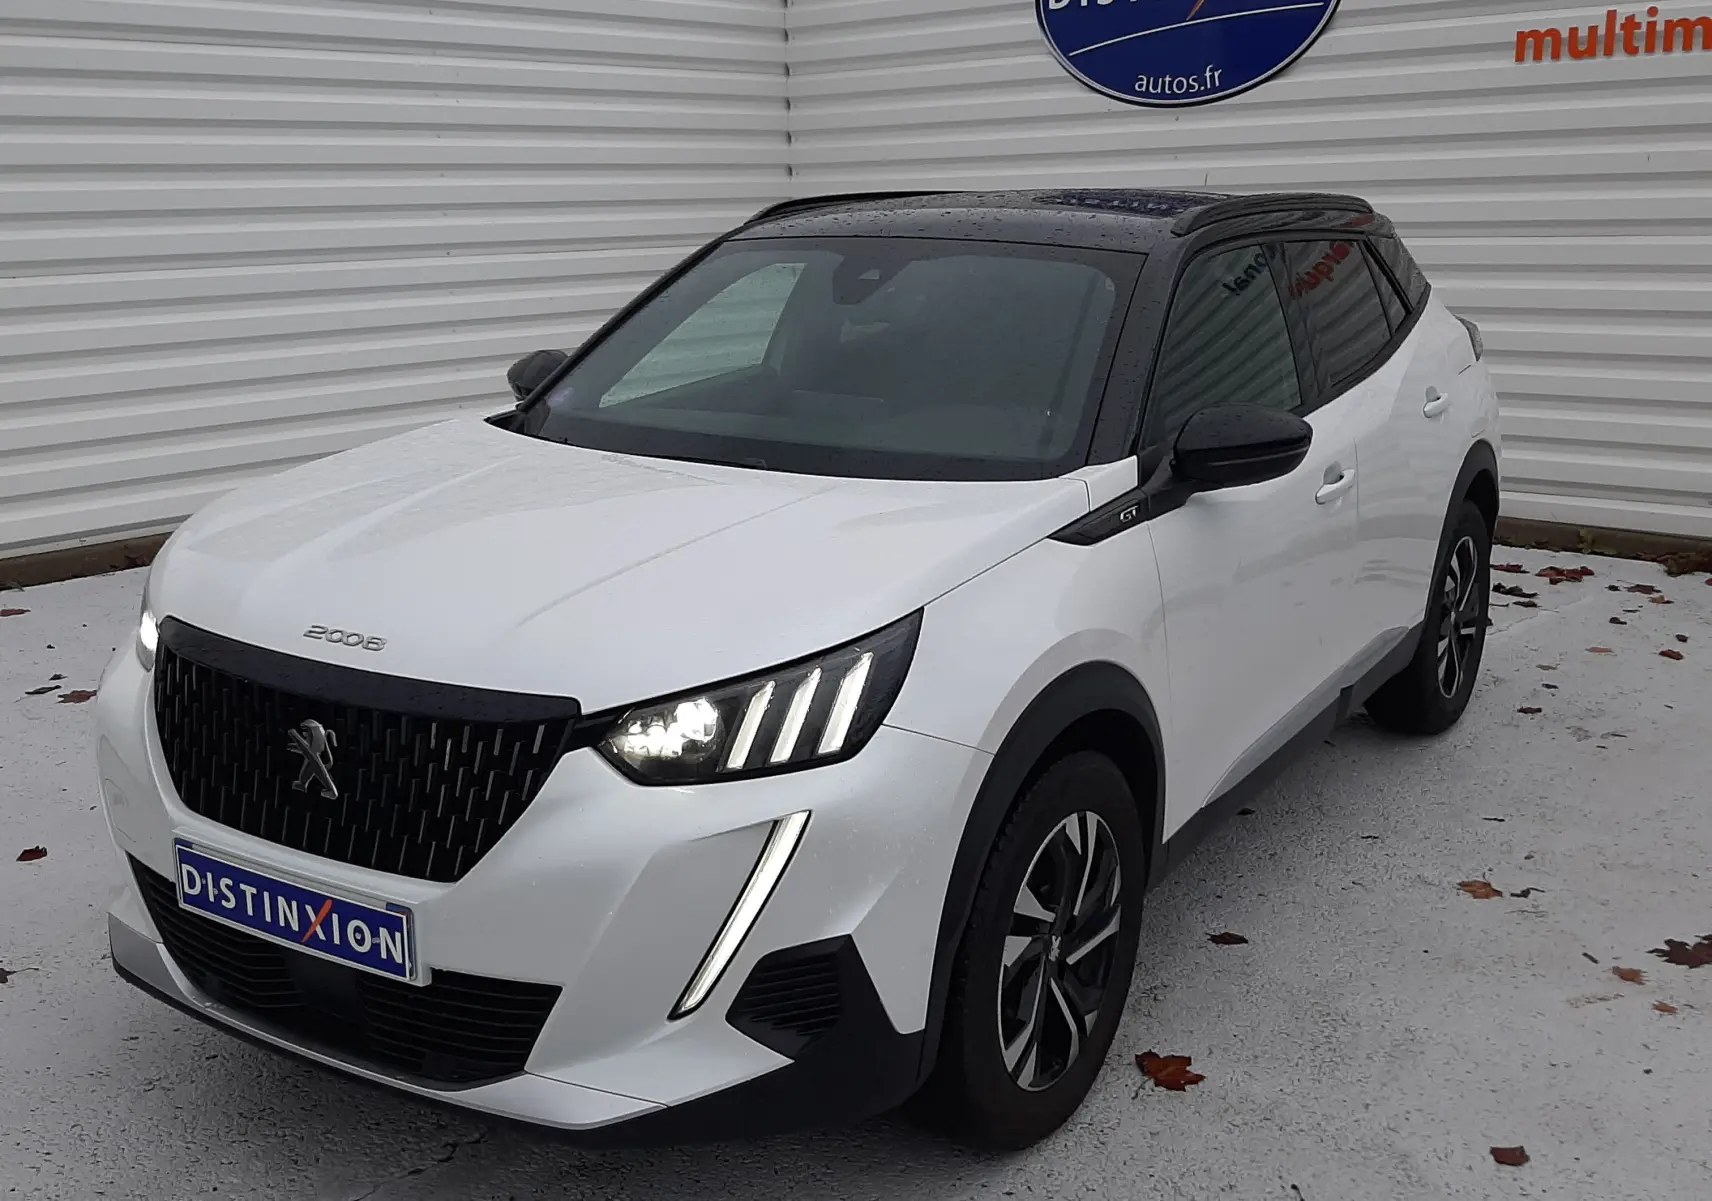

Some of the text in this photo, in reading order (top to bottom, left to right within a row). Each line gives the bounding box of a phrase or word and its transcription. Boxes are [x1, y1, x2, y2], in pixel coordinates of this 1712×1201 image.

[1515, 6, 1712, 62] multim
[1134, 64, 1223, 94] autos.fr
[1120, 505, 1139, 523] GT
[302, 624, 388, 652] 2008
[181, 862, 404, 965] DISTINXION
